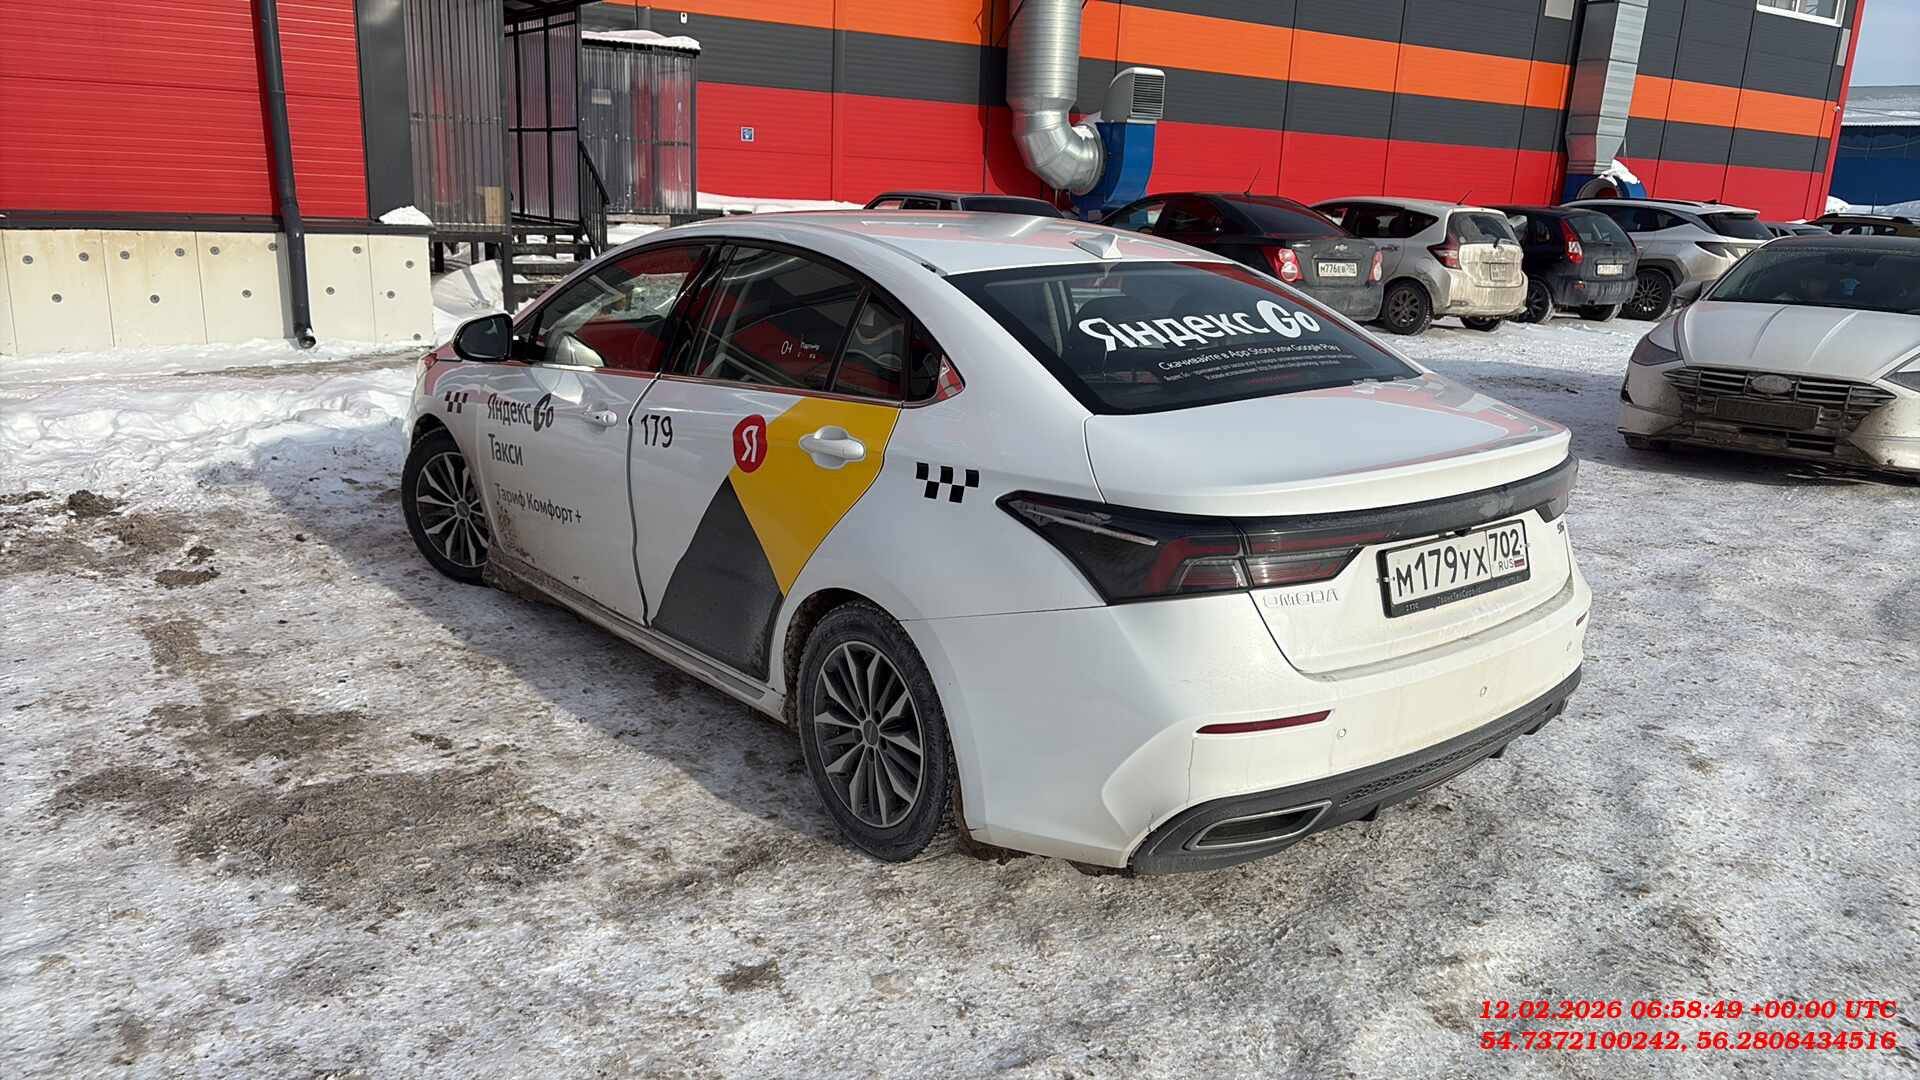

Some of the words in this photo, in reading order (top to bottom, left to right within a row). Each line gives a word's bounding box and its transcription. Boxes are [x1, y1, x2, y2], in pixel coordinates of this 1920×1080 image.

[1079, 312, 1270, 351] Яндекс
[1256, 300, 1321, 339] Go
[1158, 354, 1220, 370] Скачивайте
[487, 393, 531, 426] Яндекс
[533, 393, 554, 432] Go
[641, 414, 673, 448] 179
[488, 433, 523, 466] Такси
[741, 425, 759, 462] Я
[494, 482, 526, 510] Тариф
[526, 492, 573, 524] Комфорт
[1395, 546, 1489, 597] М179УХ
[1488, 529, 1521, 561] 702
[1499, 558, 1515, 571] RUS
